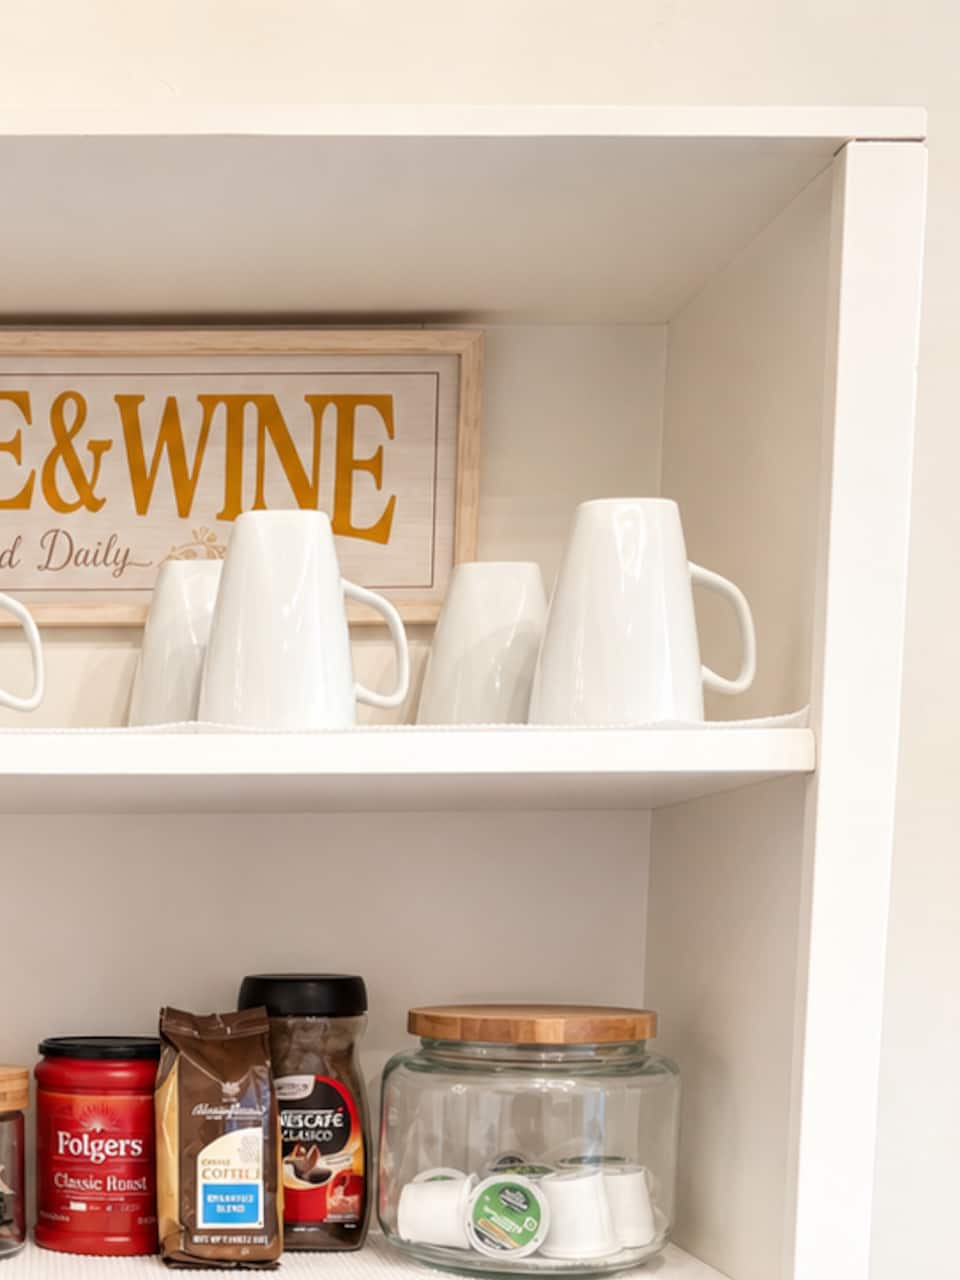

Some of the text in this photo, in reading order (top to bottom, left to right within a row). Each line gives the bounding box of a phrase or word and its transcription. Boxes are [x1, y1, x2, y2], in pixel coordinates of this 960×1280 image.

[37, 528, 152, 578] Daily
[57, 1130, 143, 1164] Folgers
[53, 1171, 147, 1192] Classic Roast
